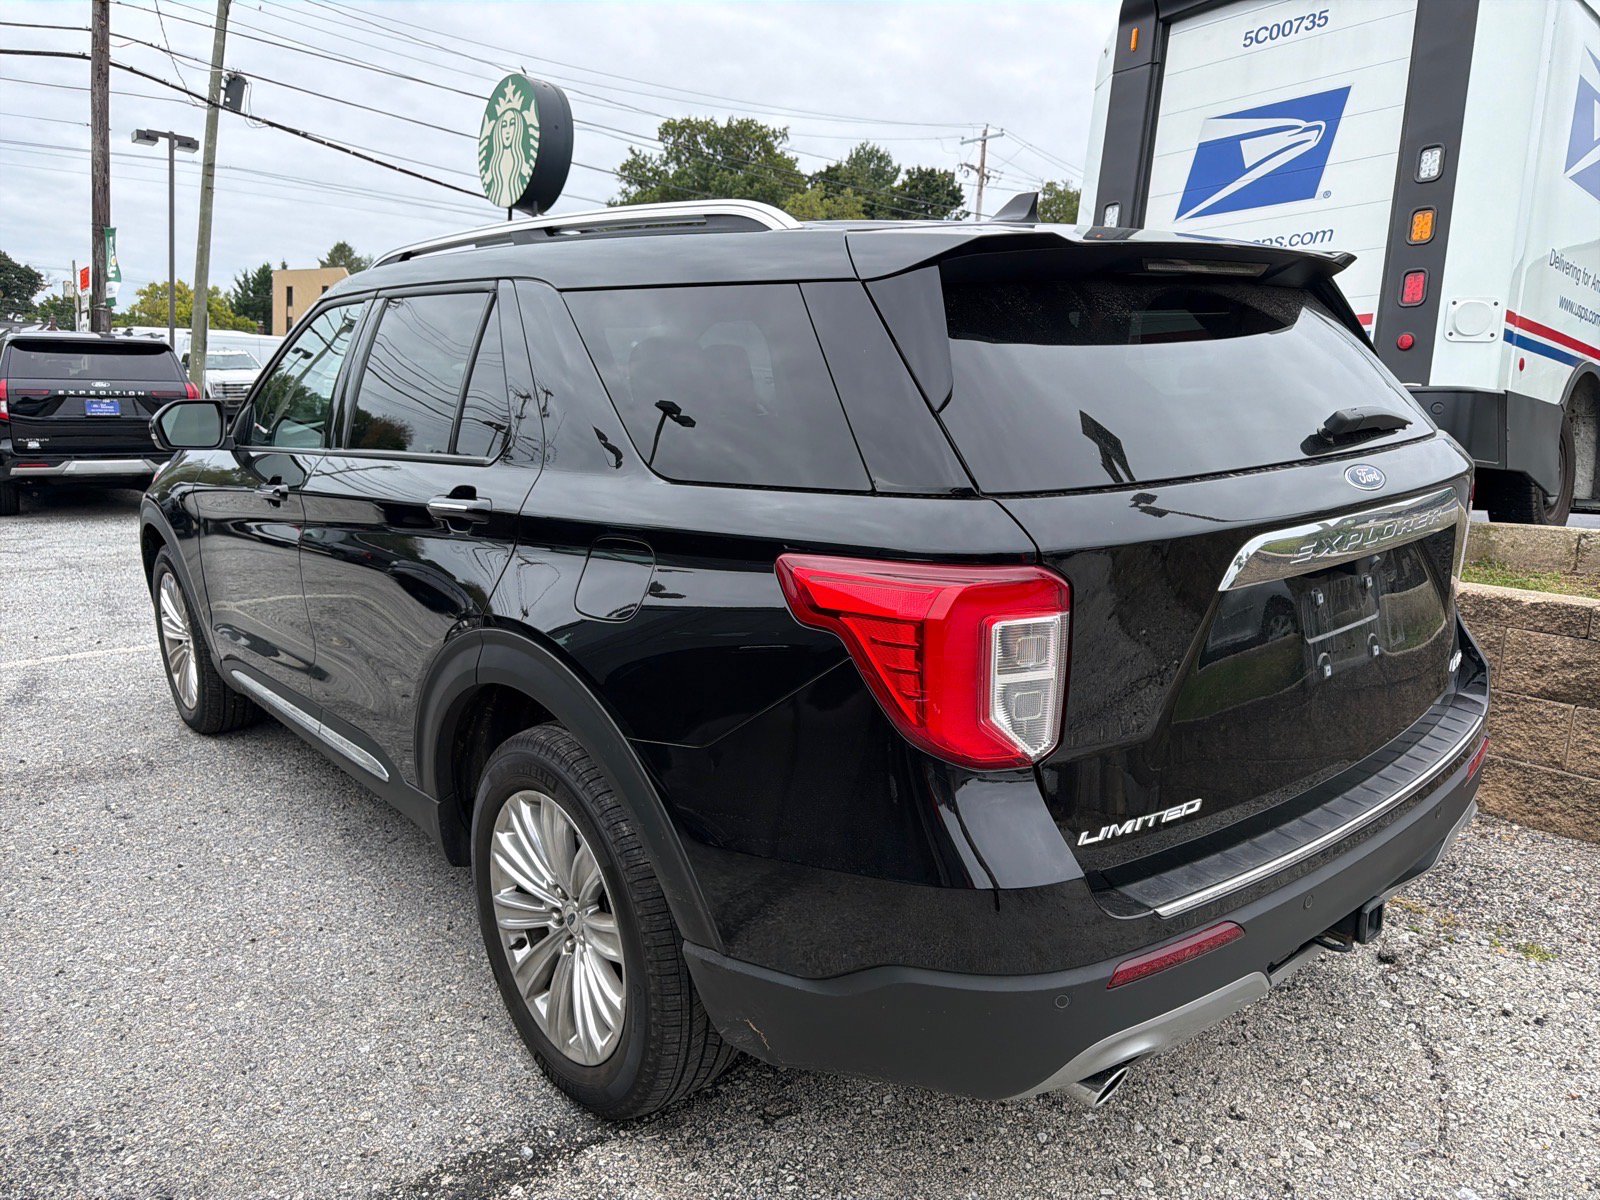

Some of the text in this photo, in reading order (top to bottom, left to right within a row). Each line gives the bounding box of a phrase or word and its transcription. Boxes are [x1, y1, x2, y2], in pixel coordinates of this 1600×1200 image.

[1242, 9, 1329, 48] 5C00735
[1253, 229, 1334, 247] s.com
[1549, 248, 1582, 286] Delivering
[1582, 267, 1592, 287] for
[1558, 294, 1600, 327] www.usps.com
[1290, 508, 1444, 564] EXPLORER
[1077, 798, 1203, 846] LIMITED
